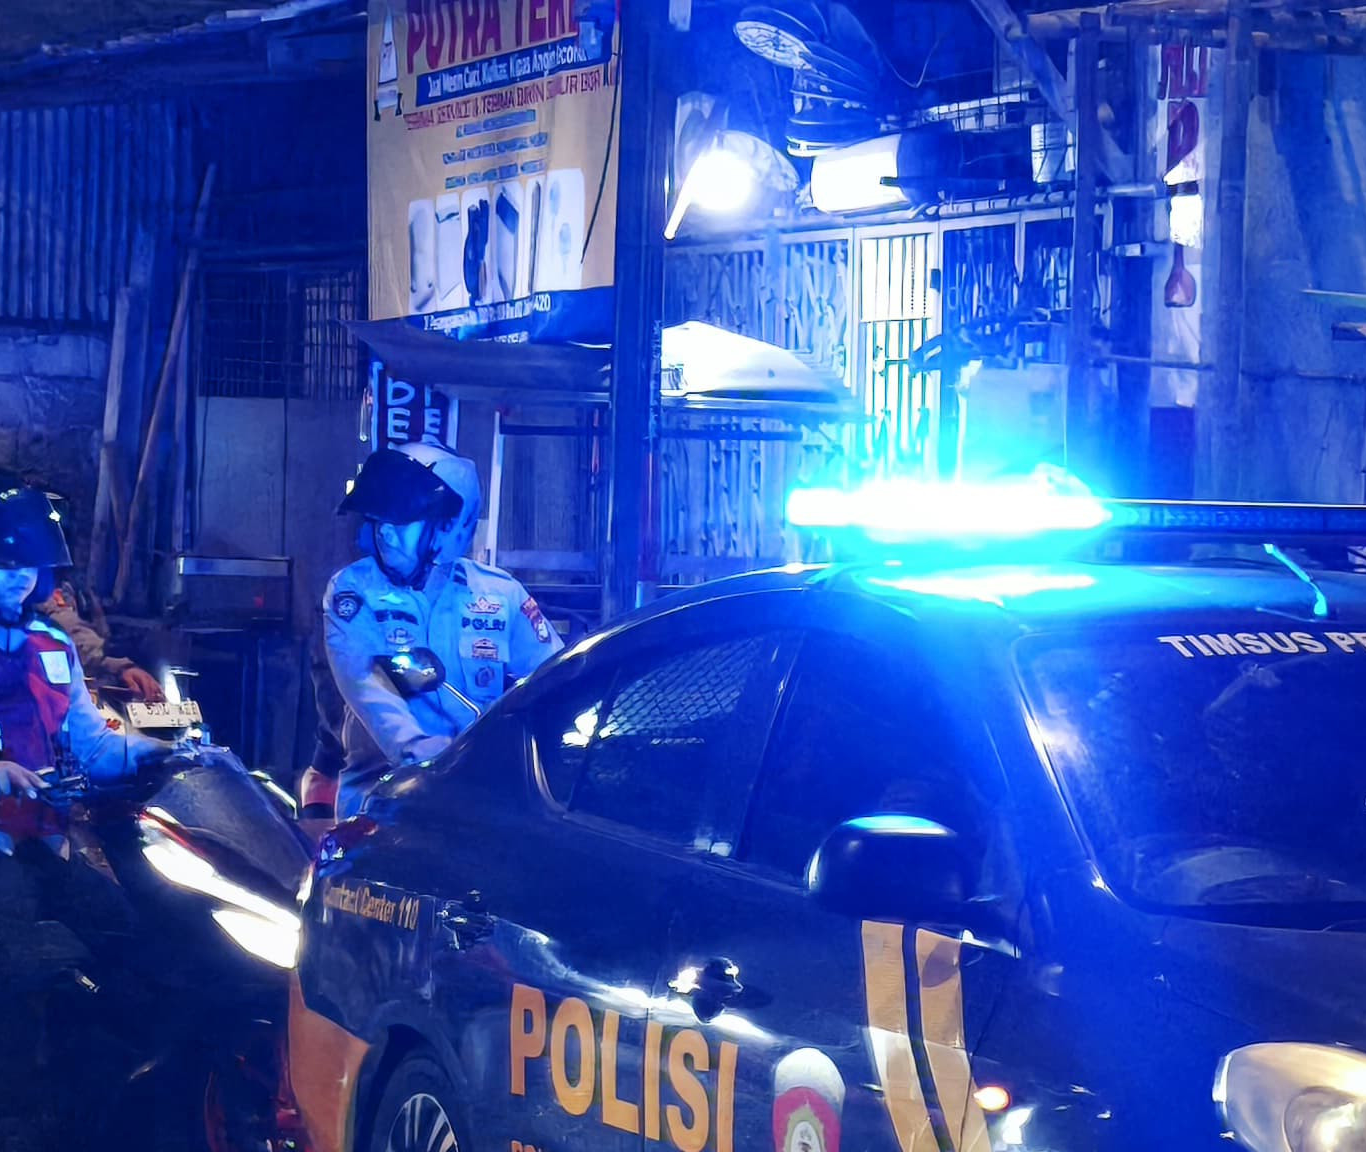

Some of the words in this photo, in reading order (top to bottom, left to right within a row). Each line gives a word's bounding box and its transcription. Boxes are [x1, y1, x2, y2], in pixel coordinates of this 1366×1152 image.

[406, 0, 502, 74] PUTRA
[1157, 631, 1328, 658] TIMSUS
[397, 895, 420, 931] 110
